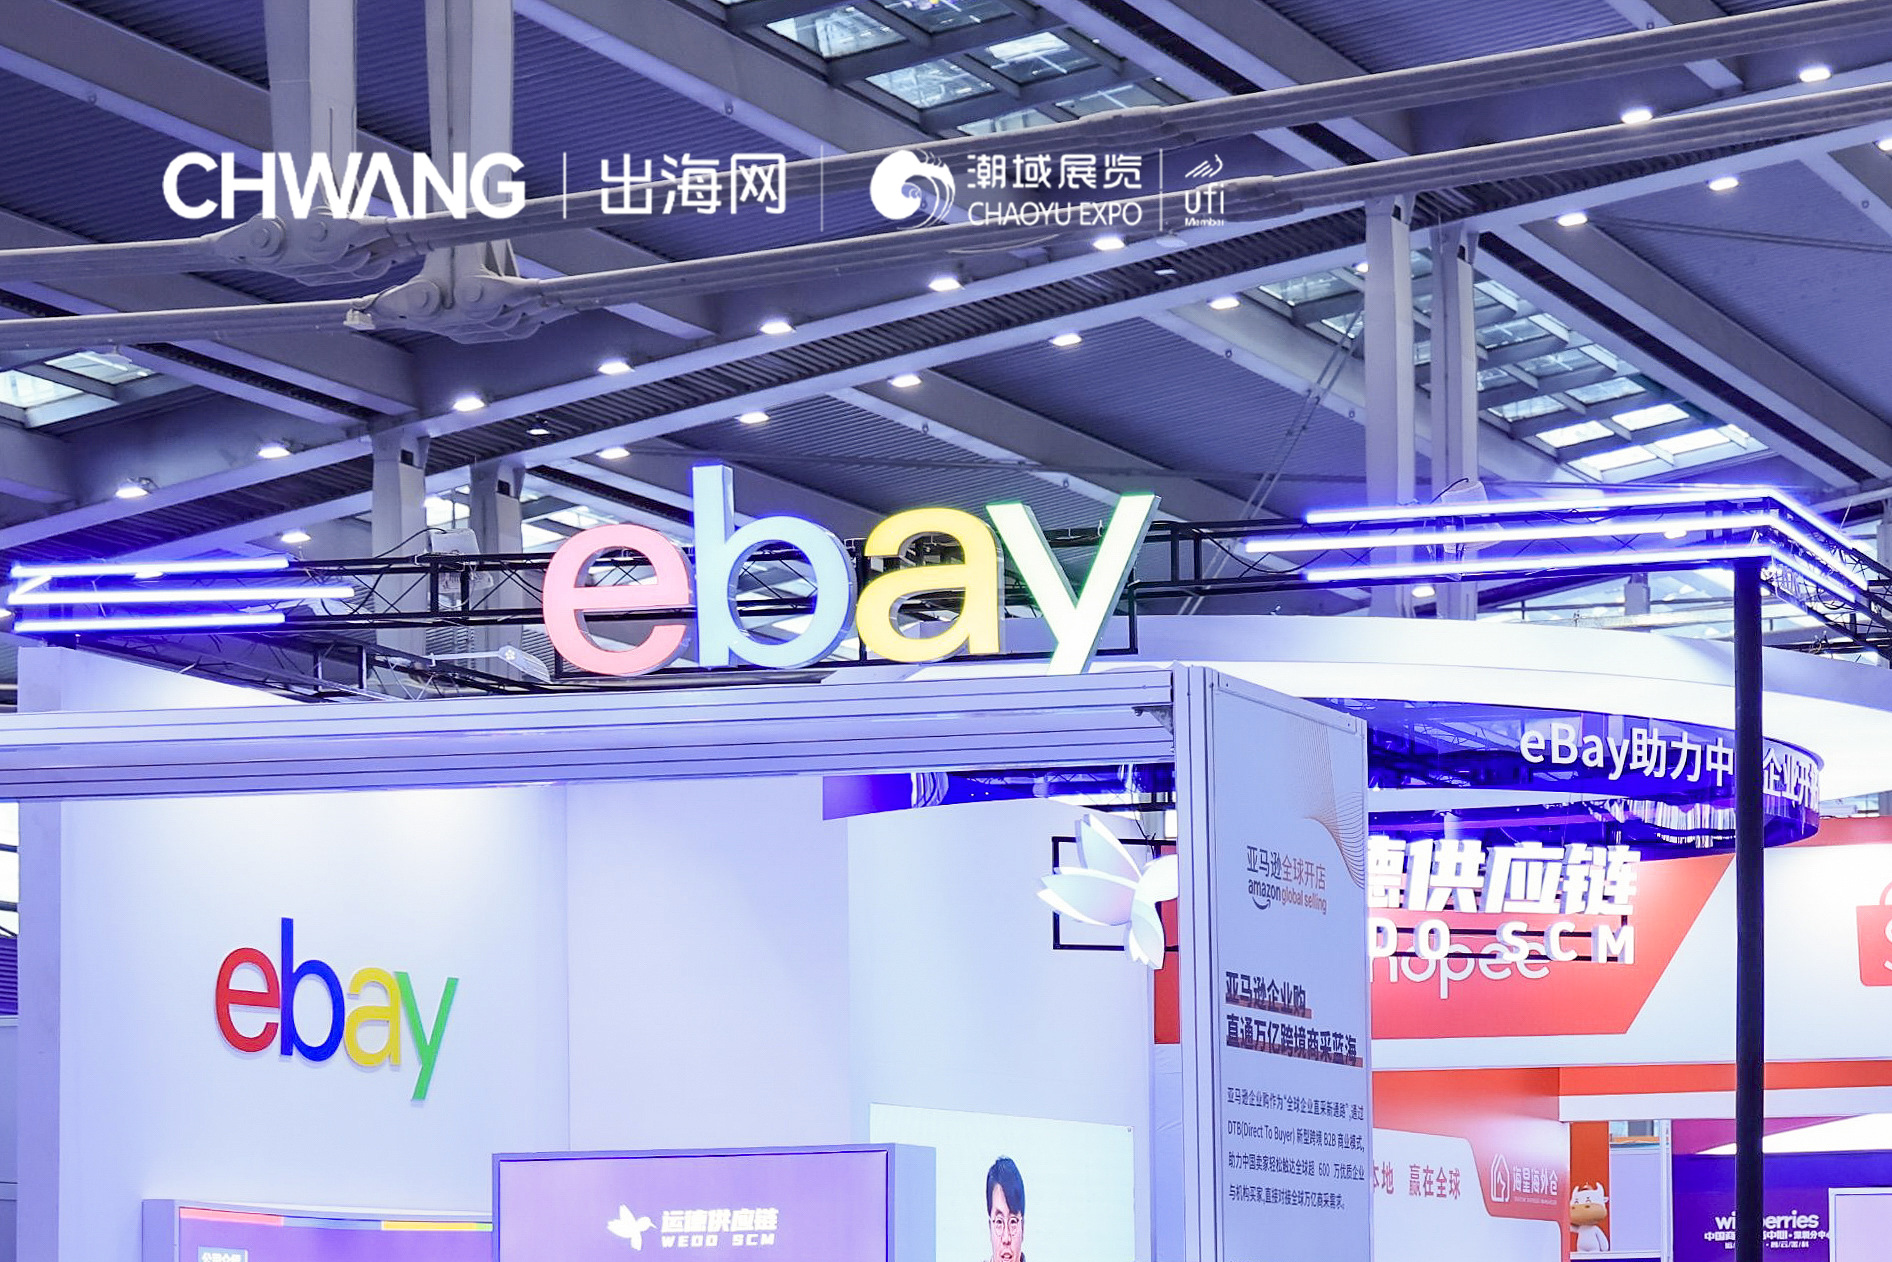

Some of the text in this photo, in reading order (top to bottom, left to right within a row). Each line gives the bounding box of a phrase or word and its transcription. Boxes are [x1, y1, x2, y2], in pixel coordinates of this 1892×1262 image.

[541, 464, 1158, 676] ebay
[1247, 845, 1326, 891] 亚马逊全球开店
[1248, 878, 1327, 915] amazon global selling
[1496, 921, 1634, 964] SCM
[215, 918, 459, 1101] ebay
[1225, 971, 1306, 1017] 亚马逊企业购
[1226, 1013, 1357, 1064] 直通万亿跨境商采蓝海
[1227, 1120, 1263, 1139] DTB(Direct
[1264, 1125, 1272, 1139] To
[1274, 1126, 1295, 1145] Buyer)
[1296, 1128, 1322, 1147] 新型跨境
[1323, 1132, 1336, 1147] B2B
[1318, 1162, 1331, 1177] 600
[1409, 1163, 1461, 1200] 赢在全球
[661, 1208, 779, 1233] 运德供应链
[1715, 1210, 1820, 1230] wierries
[732, 1233, 775, 1247] SCM
